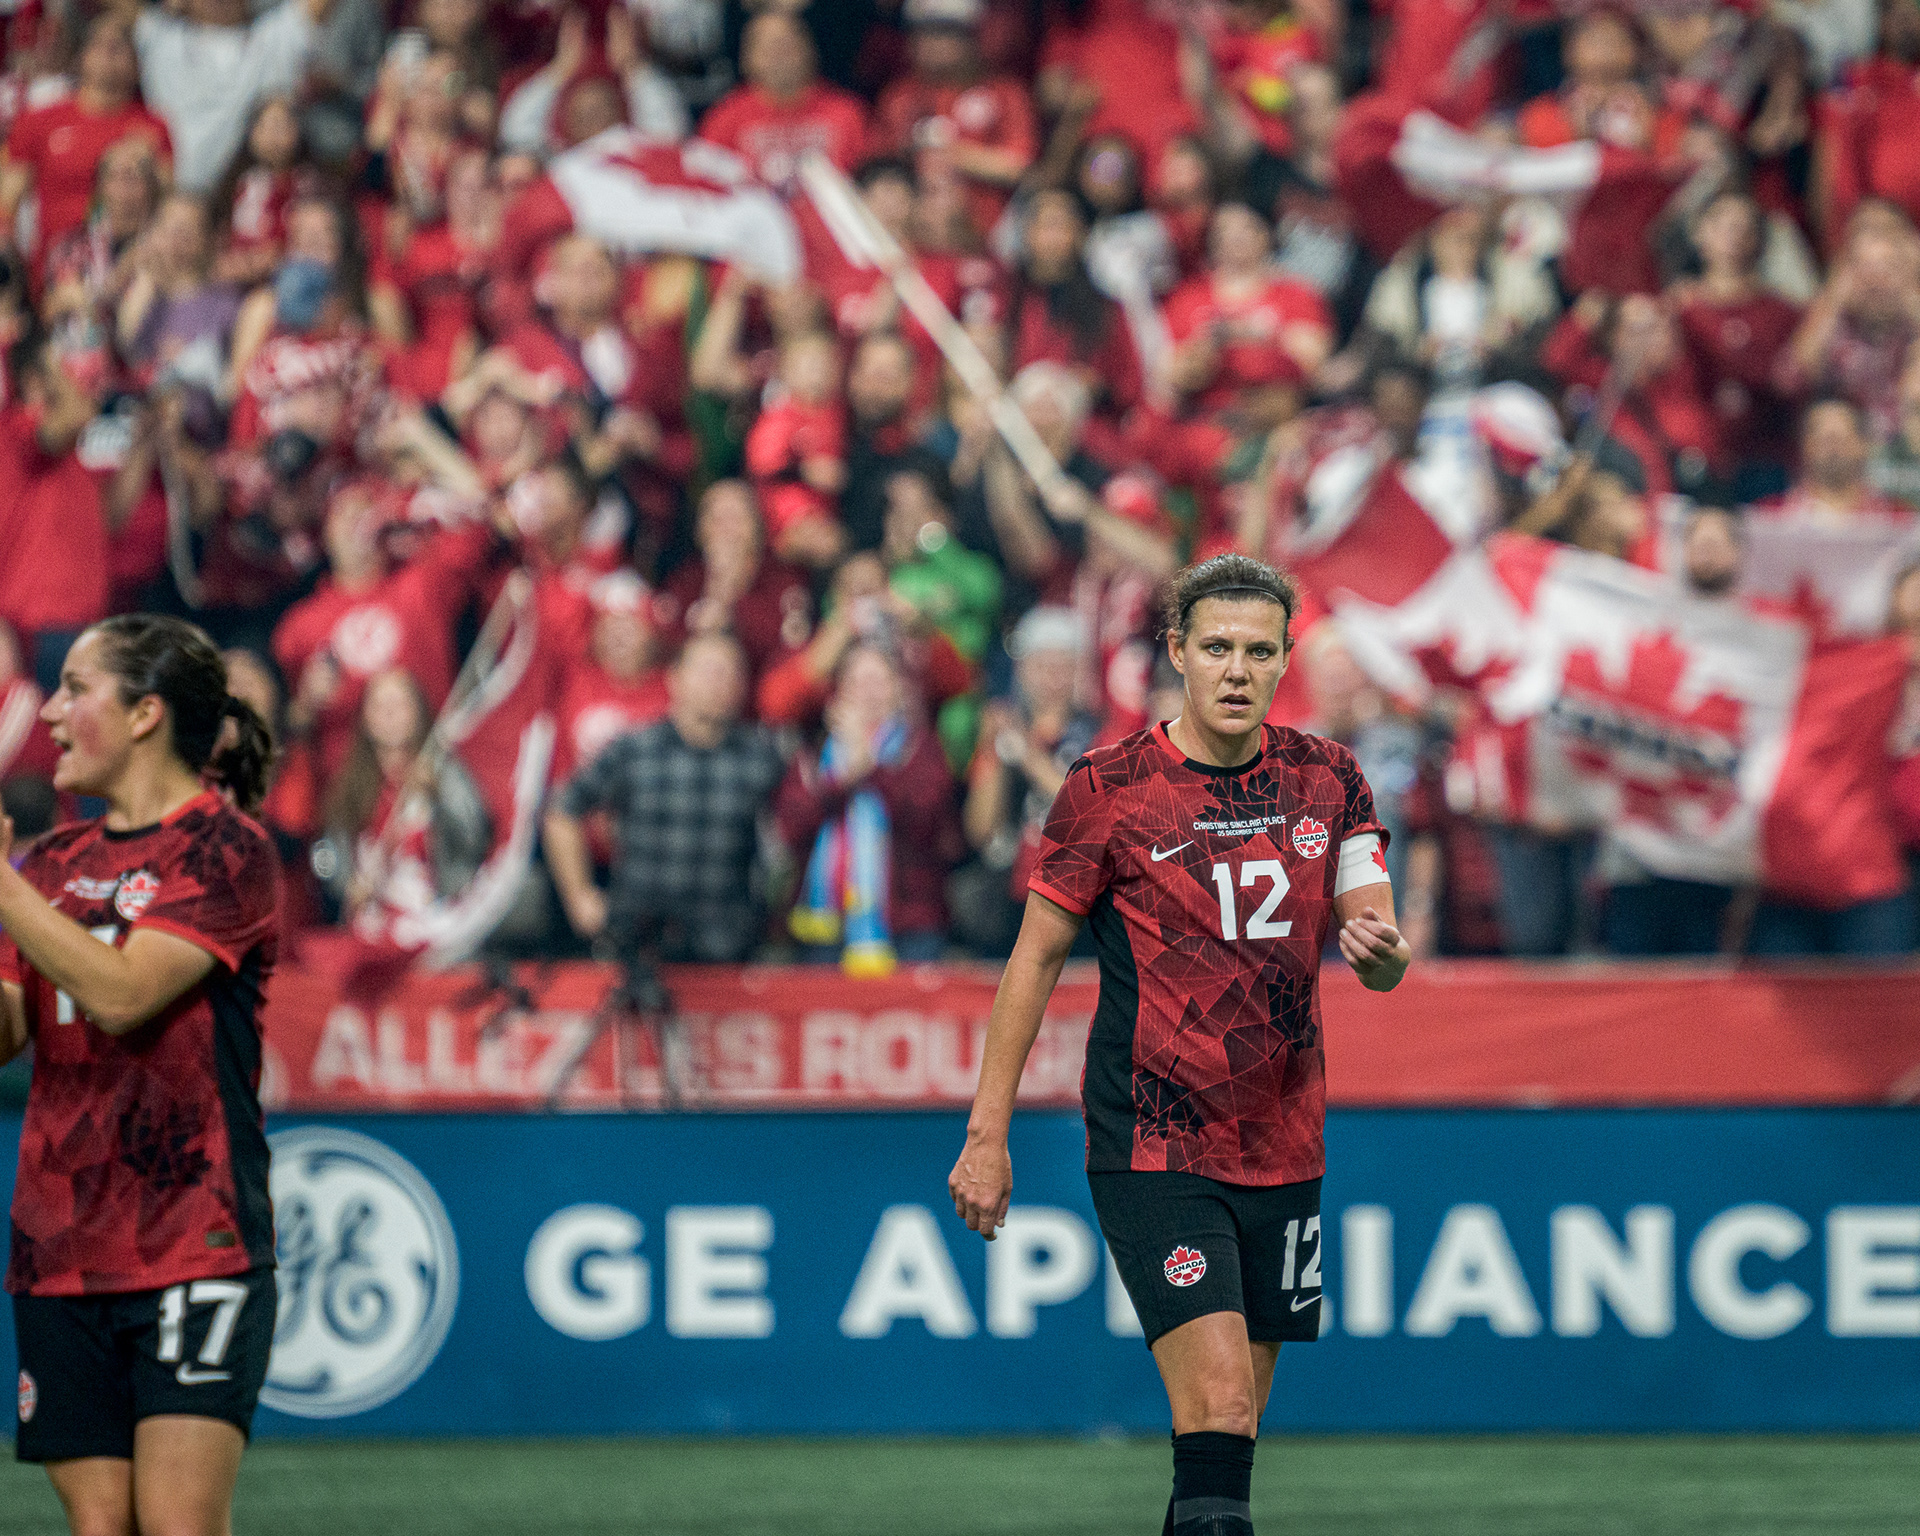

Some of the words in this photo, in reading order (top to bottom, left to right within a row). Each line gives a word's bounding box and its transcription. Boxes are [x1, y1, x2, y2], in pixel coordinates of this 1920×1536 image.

[1193, 821, 1229, 830] CHRISTINE
[1230, 818, 1262, 829] SINCLAIR
[1263, 815, 1286, 825] PLACE
[1294, 833, 1327, 843] CANADA
[1211, 859, 1293, 941] 12
[310, 1003, 600, 1099] ALLEZ
[523, 1204, 776, 1341] GE
[837, 1204, 1920, 1341] APIANCE
[1166, 1260, 1204, 1276] CANADA
[1281, 1214, 1322, 1290] 12
[157, 1280, 249, 1366] 17
